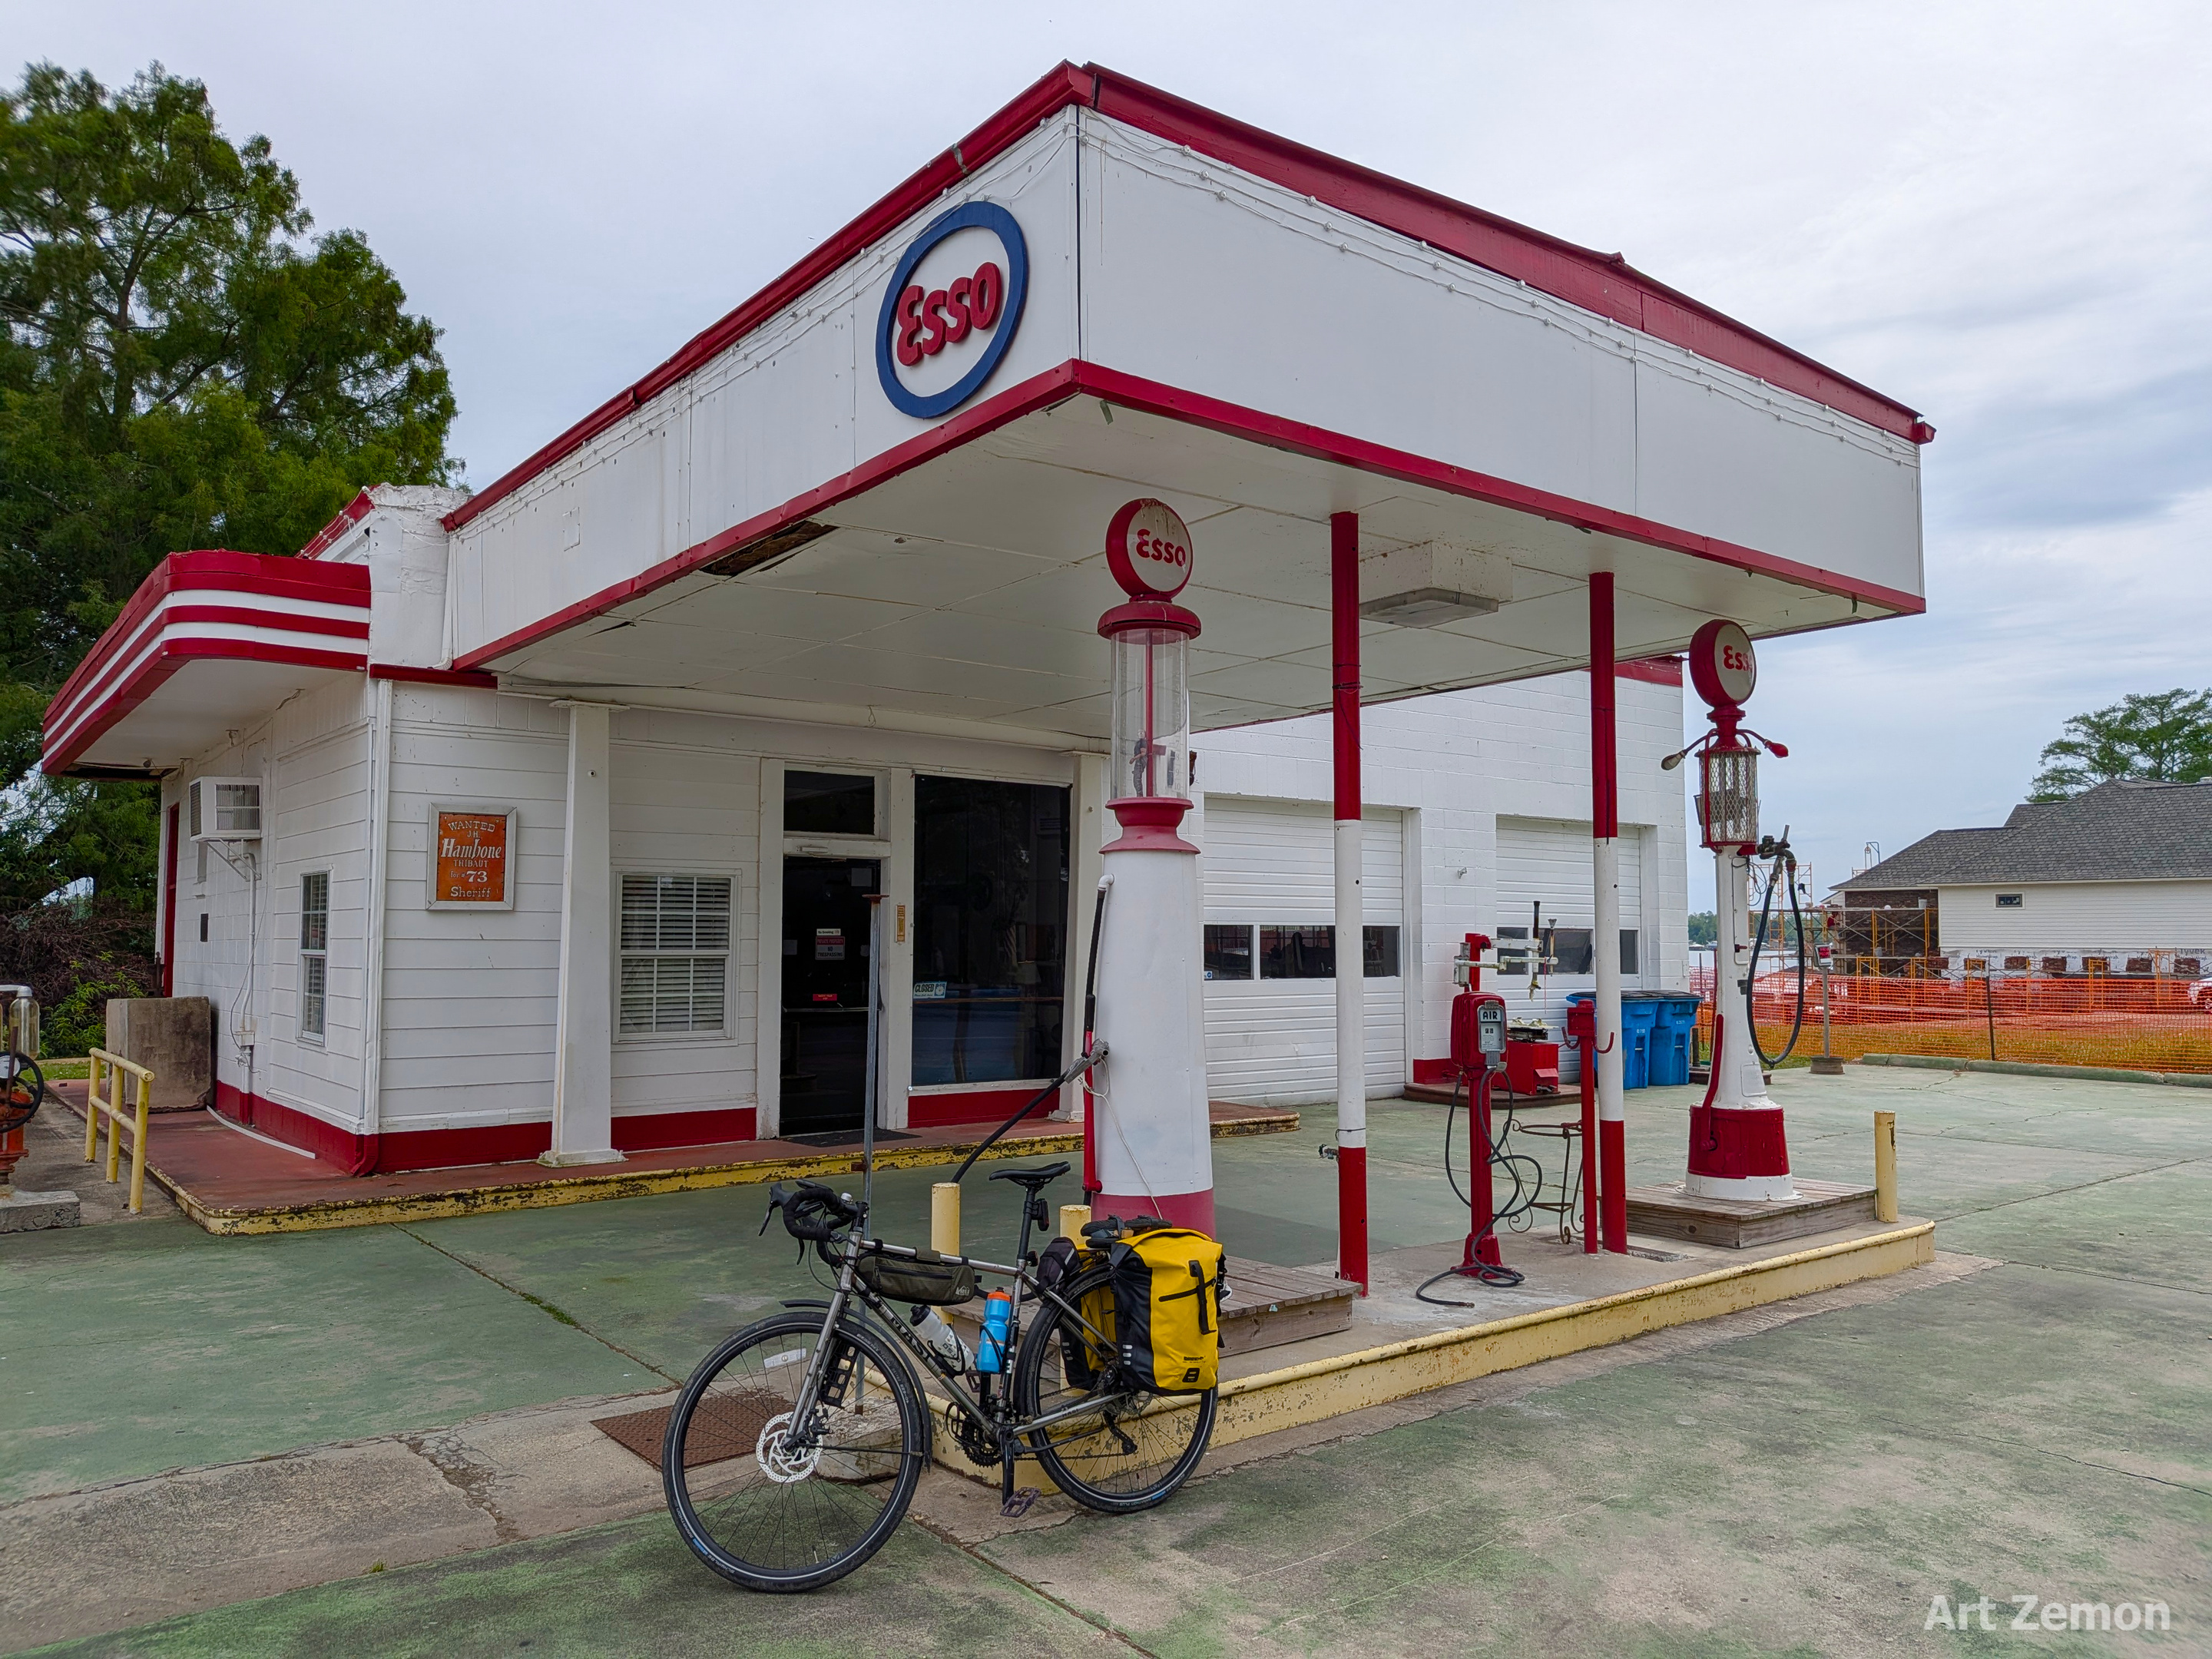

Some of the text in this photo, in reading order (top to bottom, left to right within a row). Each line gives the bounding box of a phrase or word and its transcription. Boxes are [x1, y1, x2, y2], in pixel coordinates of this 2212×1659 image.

[448, 820, 495, 833] WANTED
[440, 838, 502, 859] Hambone
[453, 859, 489, 868] THIBAUT
[450, 886, 492, 897] Sheriff
[915, 983, 935, 992] CLOSED
[1482, 1011, 1498, 1020] AIR
[889, 1316, 931, 1363] MASI
